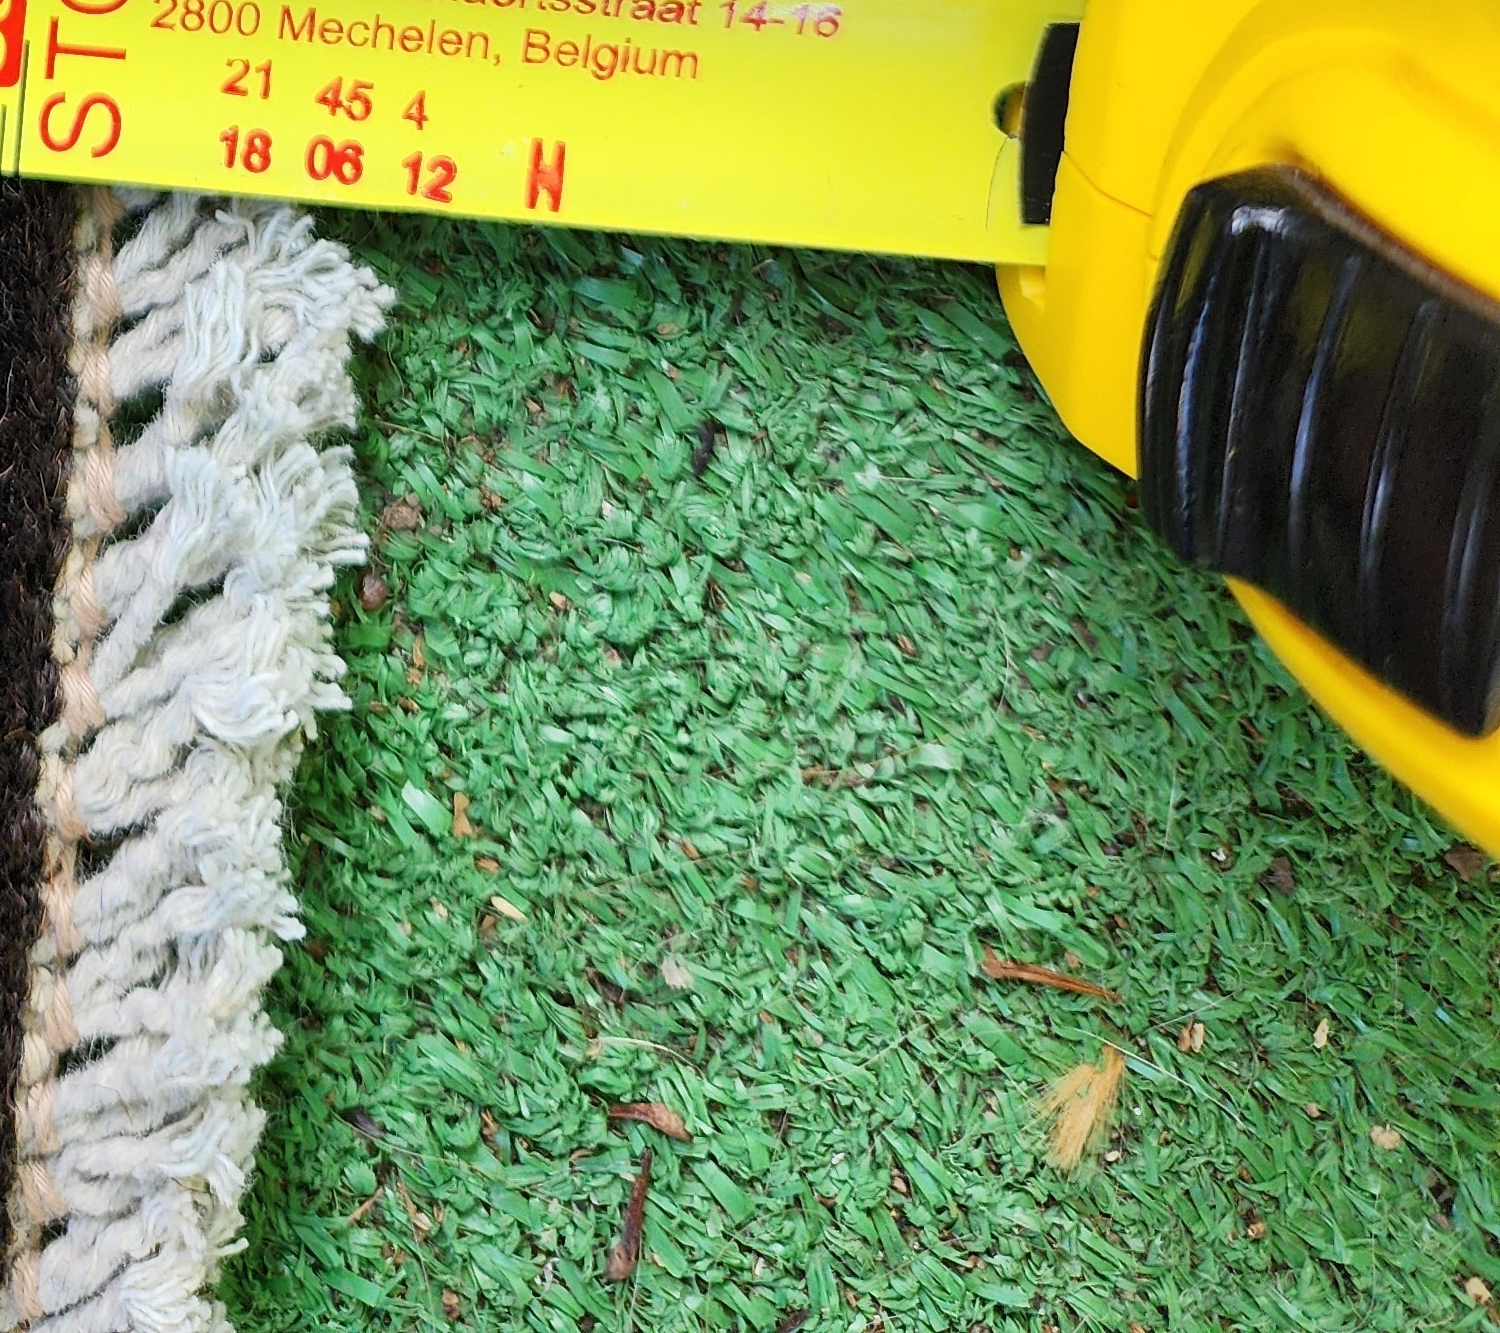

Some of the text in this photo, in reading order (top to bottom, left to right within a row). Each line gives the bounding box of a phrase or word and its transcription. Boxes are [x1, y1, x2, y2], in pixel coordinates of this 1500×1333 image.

[278, 4, 502, 67] Mechelen,
[521, 28, 699, 81] Belgium
[220, 58, 429, 131] 21 45 4
[220, 125, 273, 173] 18
[304, 134, 364, 185] 06
[402, 151, 458, 203] 12
